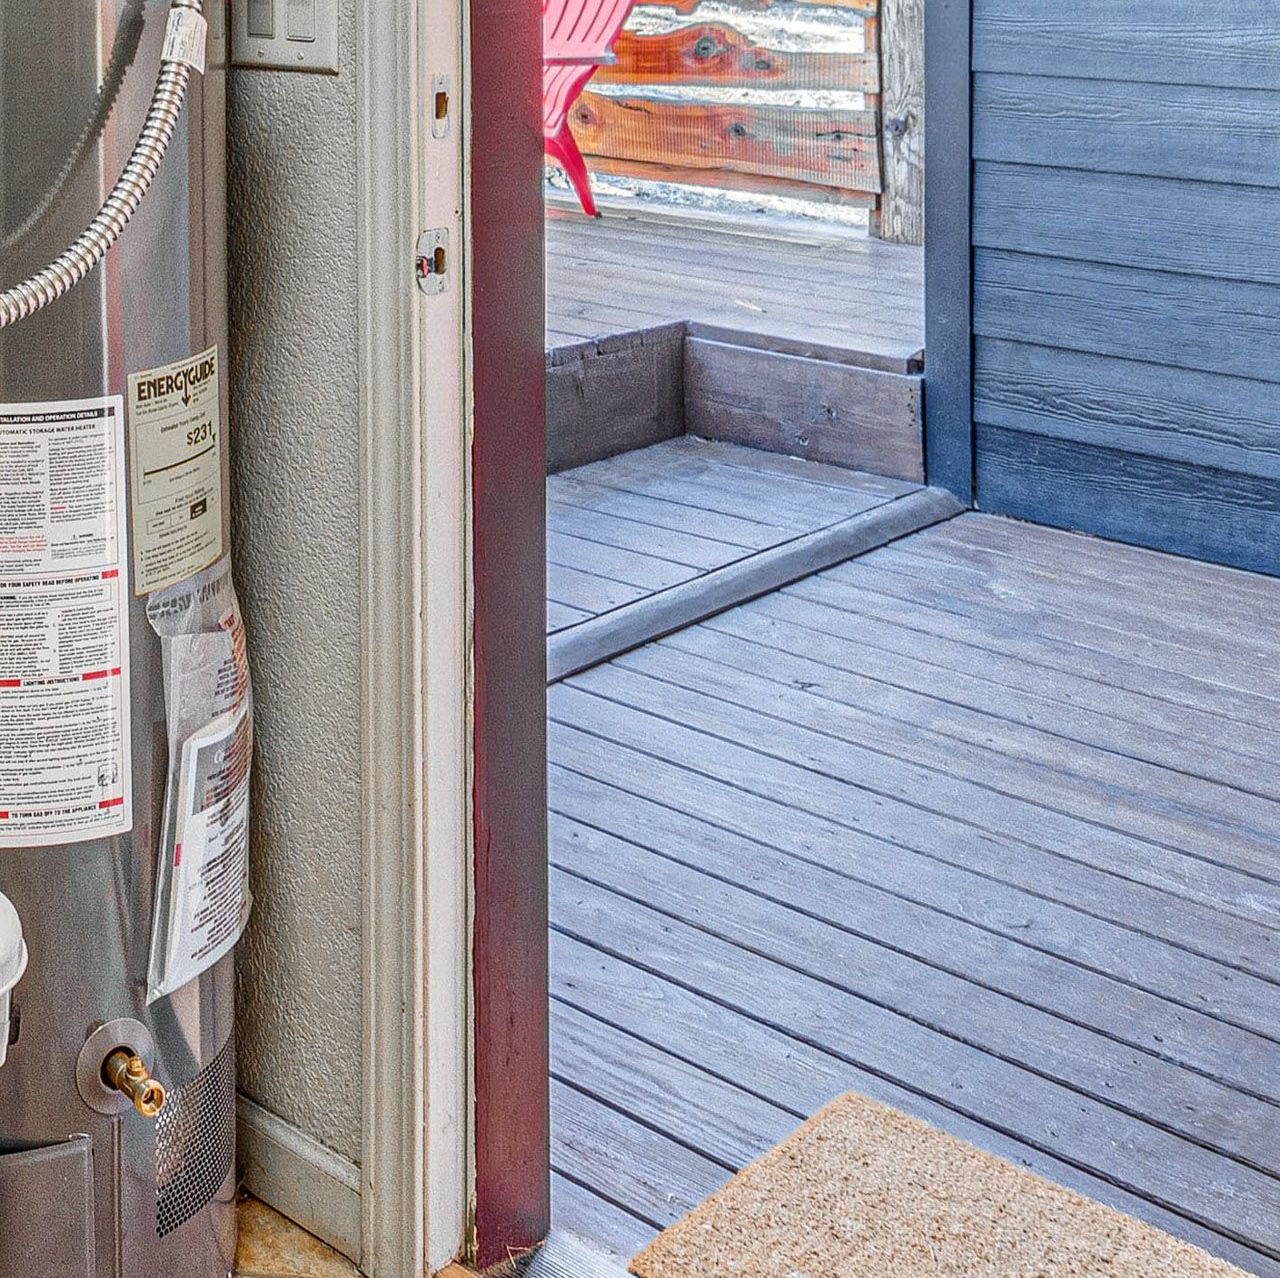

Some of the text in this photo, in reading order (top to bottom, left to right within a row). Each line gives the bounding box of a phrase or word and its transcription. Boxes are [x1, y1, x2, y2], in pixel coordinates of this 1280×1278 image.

[32, 414, 44, 422] AND
[46, 413, 76, 422] OPERATION
[77, 411, 98, 419] DETAILS
[187, 420, 212, 446] $231
[75, 575, 99, 583] OPERATING
[46, 676, 80, 685] INSTRUCTIONS
[72, 805, 97, 814] APPLIANCE
